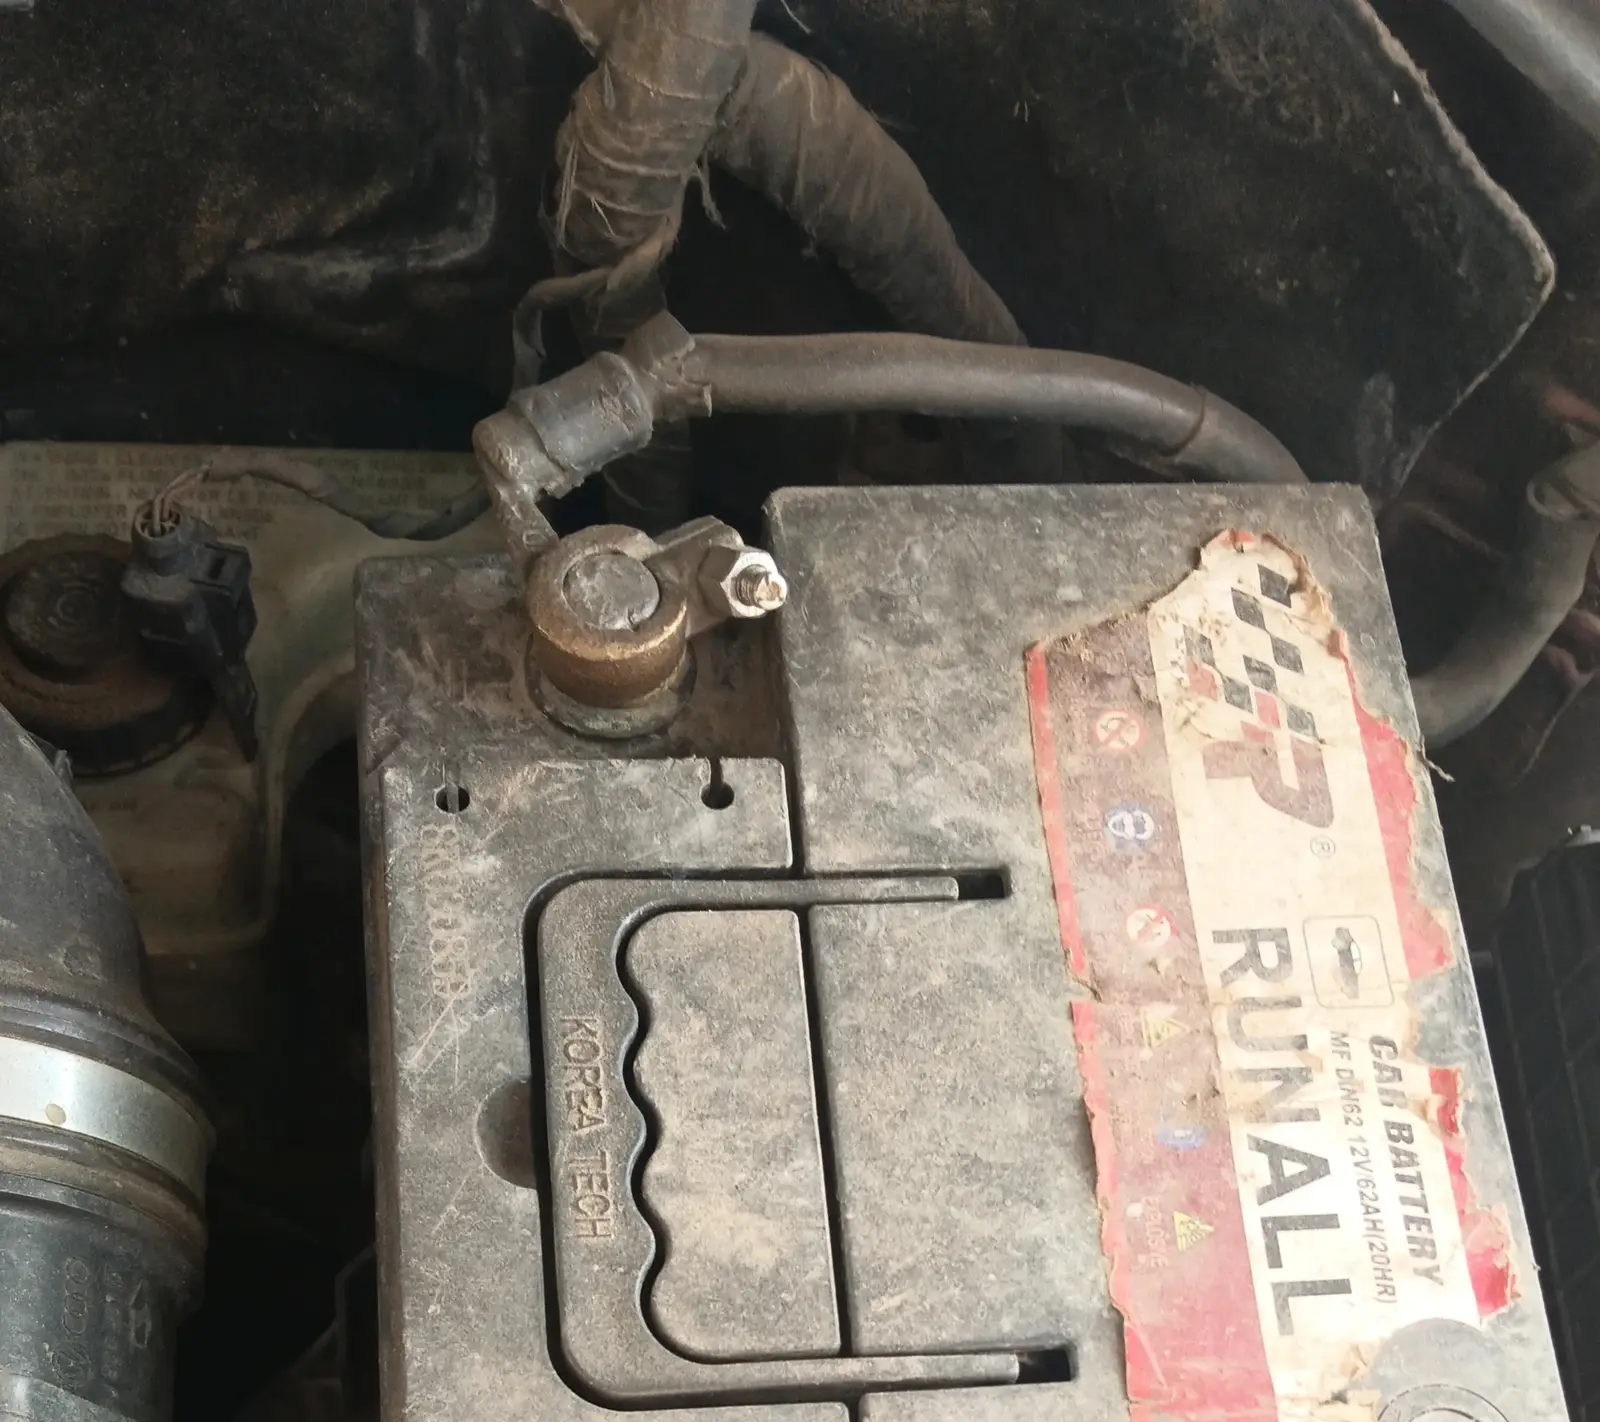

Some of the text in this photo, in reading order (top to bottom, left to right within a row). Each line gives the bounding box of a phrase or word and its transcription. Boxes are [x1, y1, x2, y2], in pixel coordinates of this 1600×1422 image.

[560, 1016, 613, 1240] KOREA TECH
[1212, 926, 1353, 1336] RUNALL
[1330, 1031, 1353, 1061] MF
[1336, 1068, 1364, 1126] DIN62
[1369, 1035, 1444, 1286] CAR BATTERY
